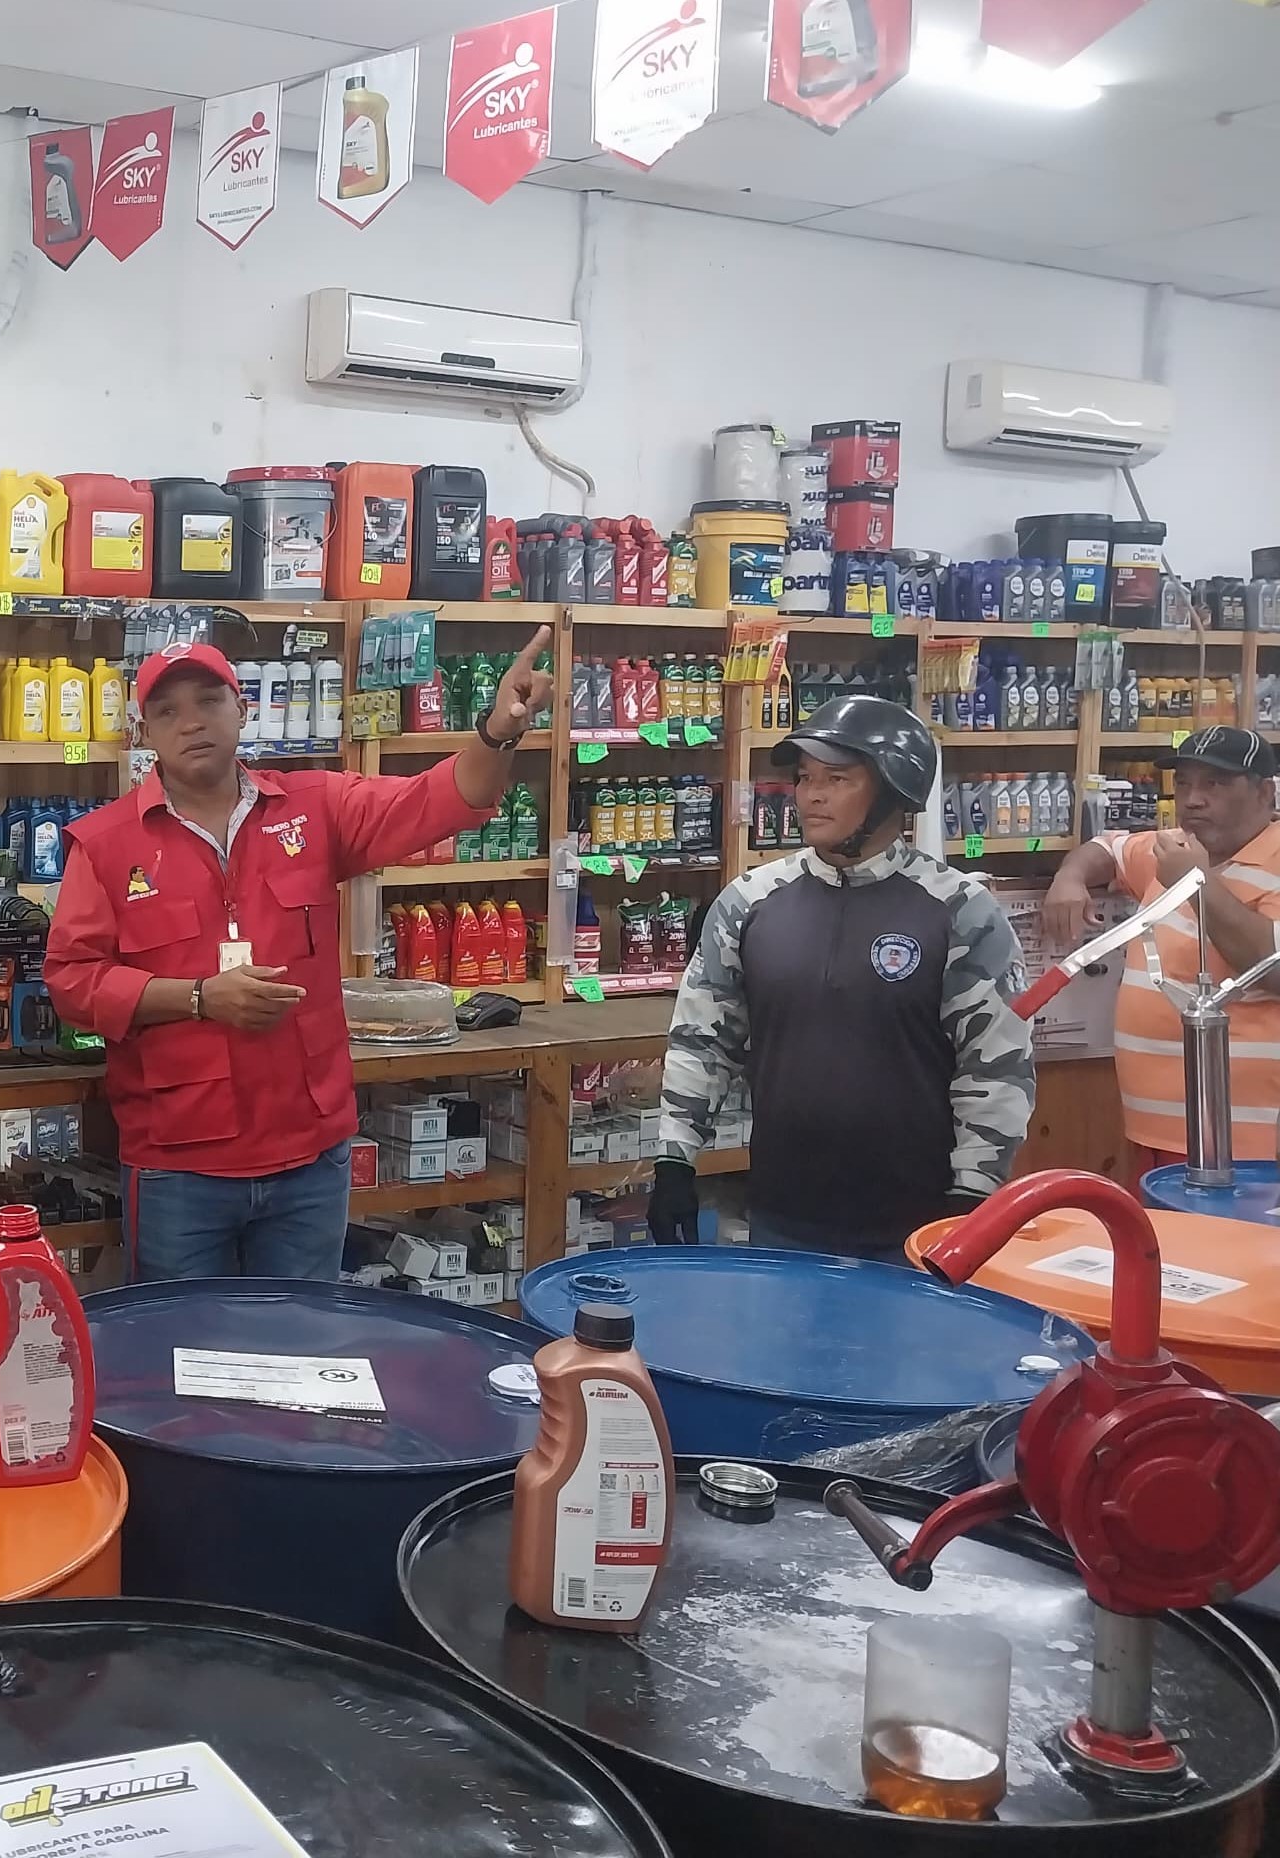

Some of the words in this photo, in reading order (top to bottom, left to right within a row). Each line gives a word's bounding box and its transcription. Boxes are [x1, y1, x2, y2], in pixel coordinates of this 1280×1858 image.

[642, 40, 697, 78] SKY
[484, 83, 531, 118] SKY
[473, 116, 538, 140] Lubricantes
[230, 146, 265, 174] SKY
[122, 166, 156, 190] SKY
[222, 175, 269, 192] Lubricantes
[113, 193, 158, 205] Lubricantes
[14, 516, 39, 524] HELIX
[491, 565, 510, 577] OIL
[81, 1842, 91, 1851] A
[94, 1826, 170, 1847] GASOLINA
[95, 1823, 136, 1837] PARA
